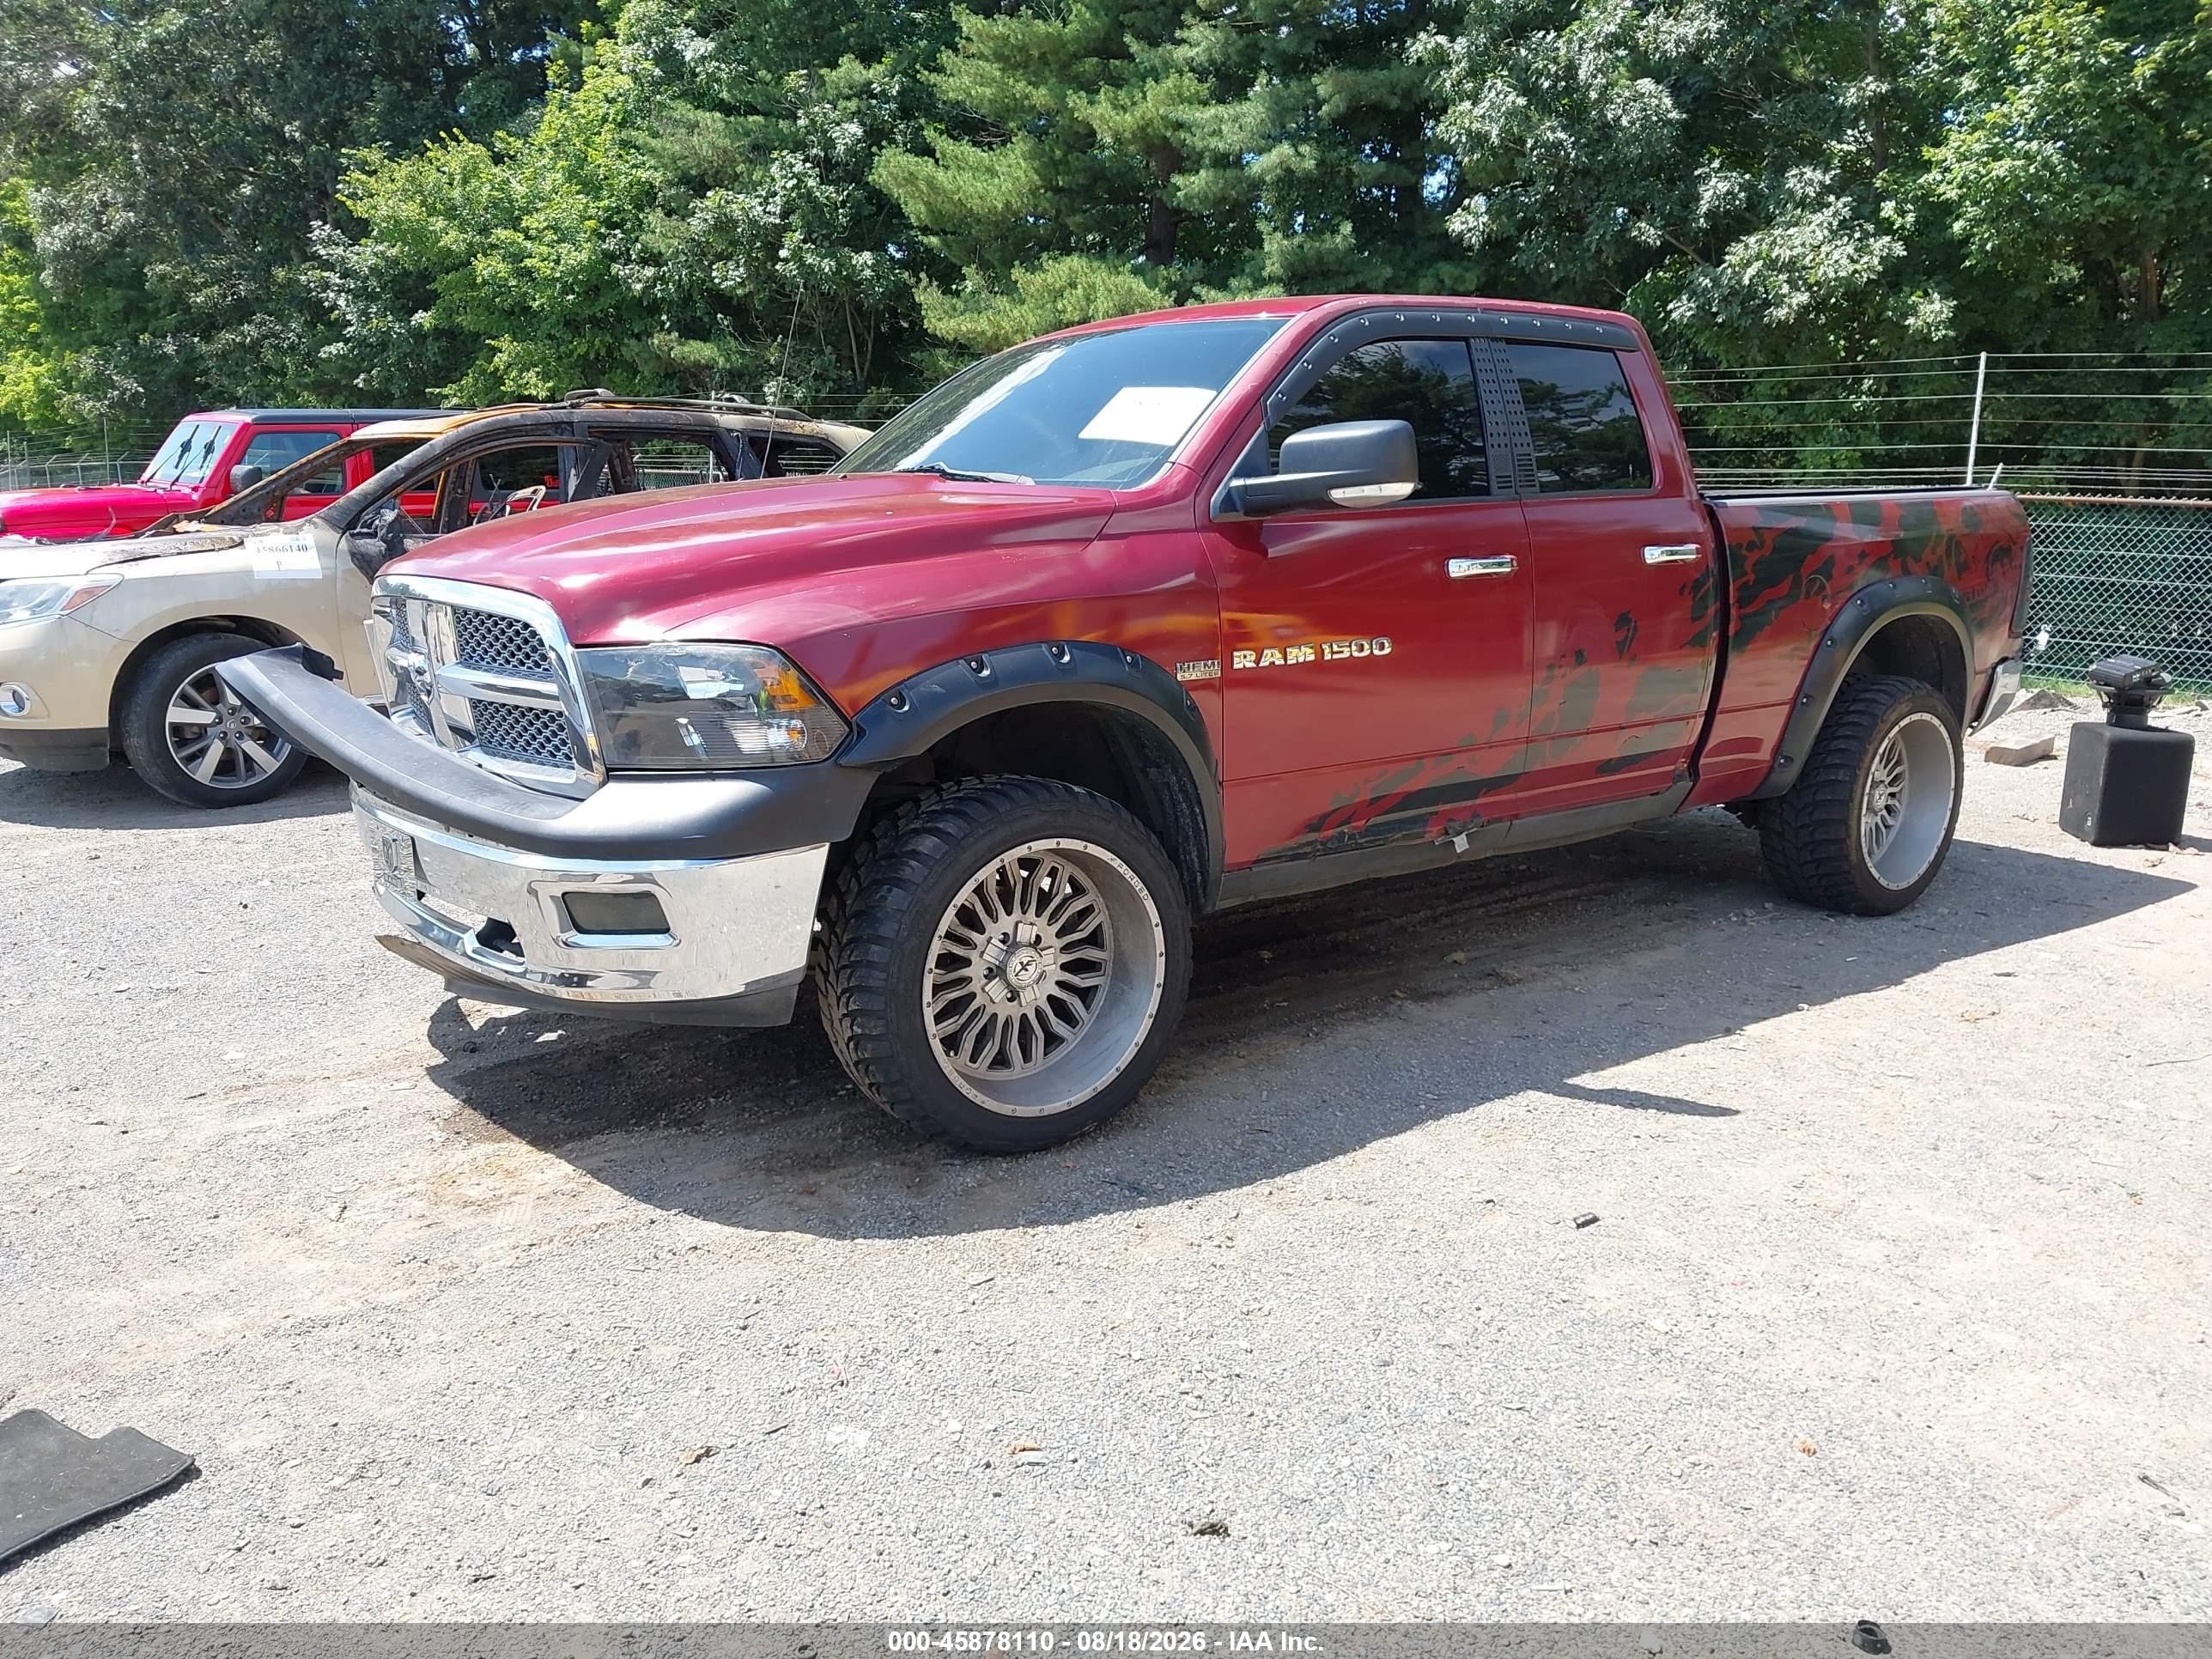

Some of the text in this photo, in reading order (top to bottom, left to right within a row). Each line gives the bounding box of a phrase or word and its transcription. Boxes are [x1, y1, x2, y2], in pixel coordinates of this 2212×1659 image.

[1232, 636, 1393, 670] RAM 1500
[1179, 660, 1220, 672] HEMI
